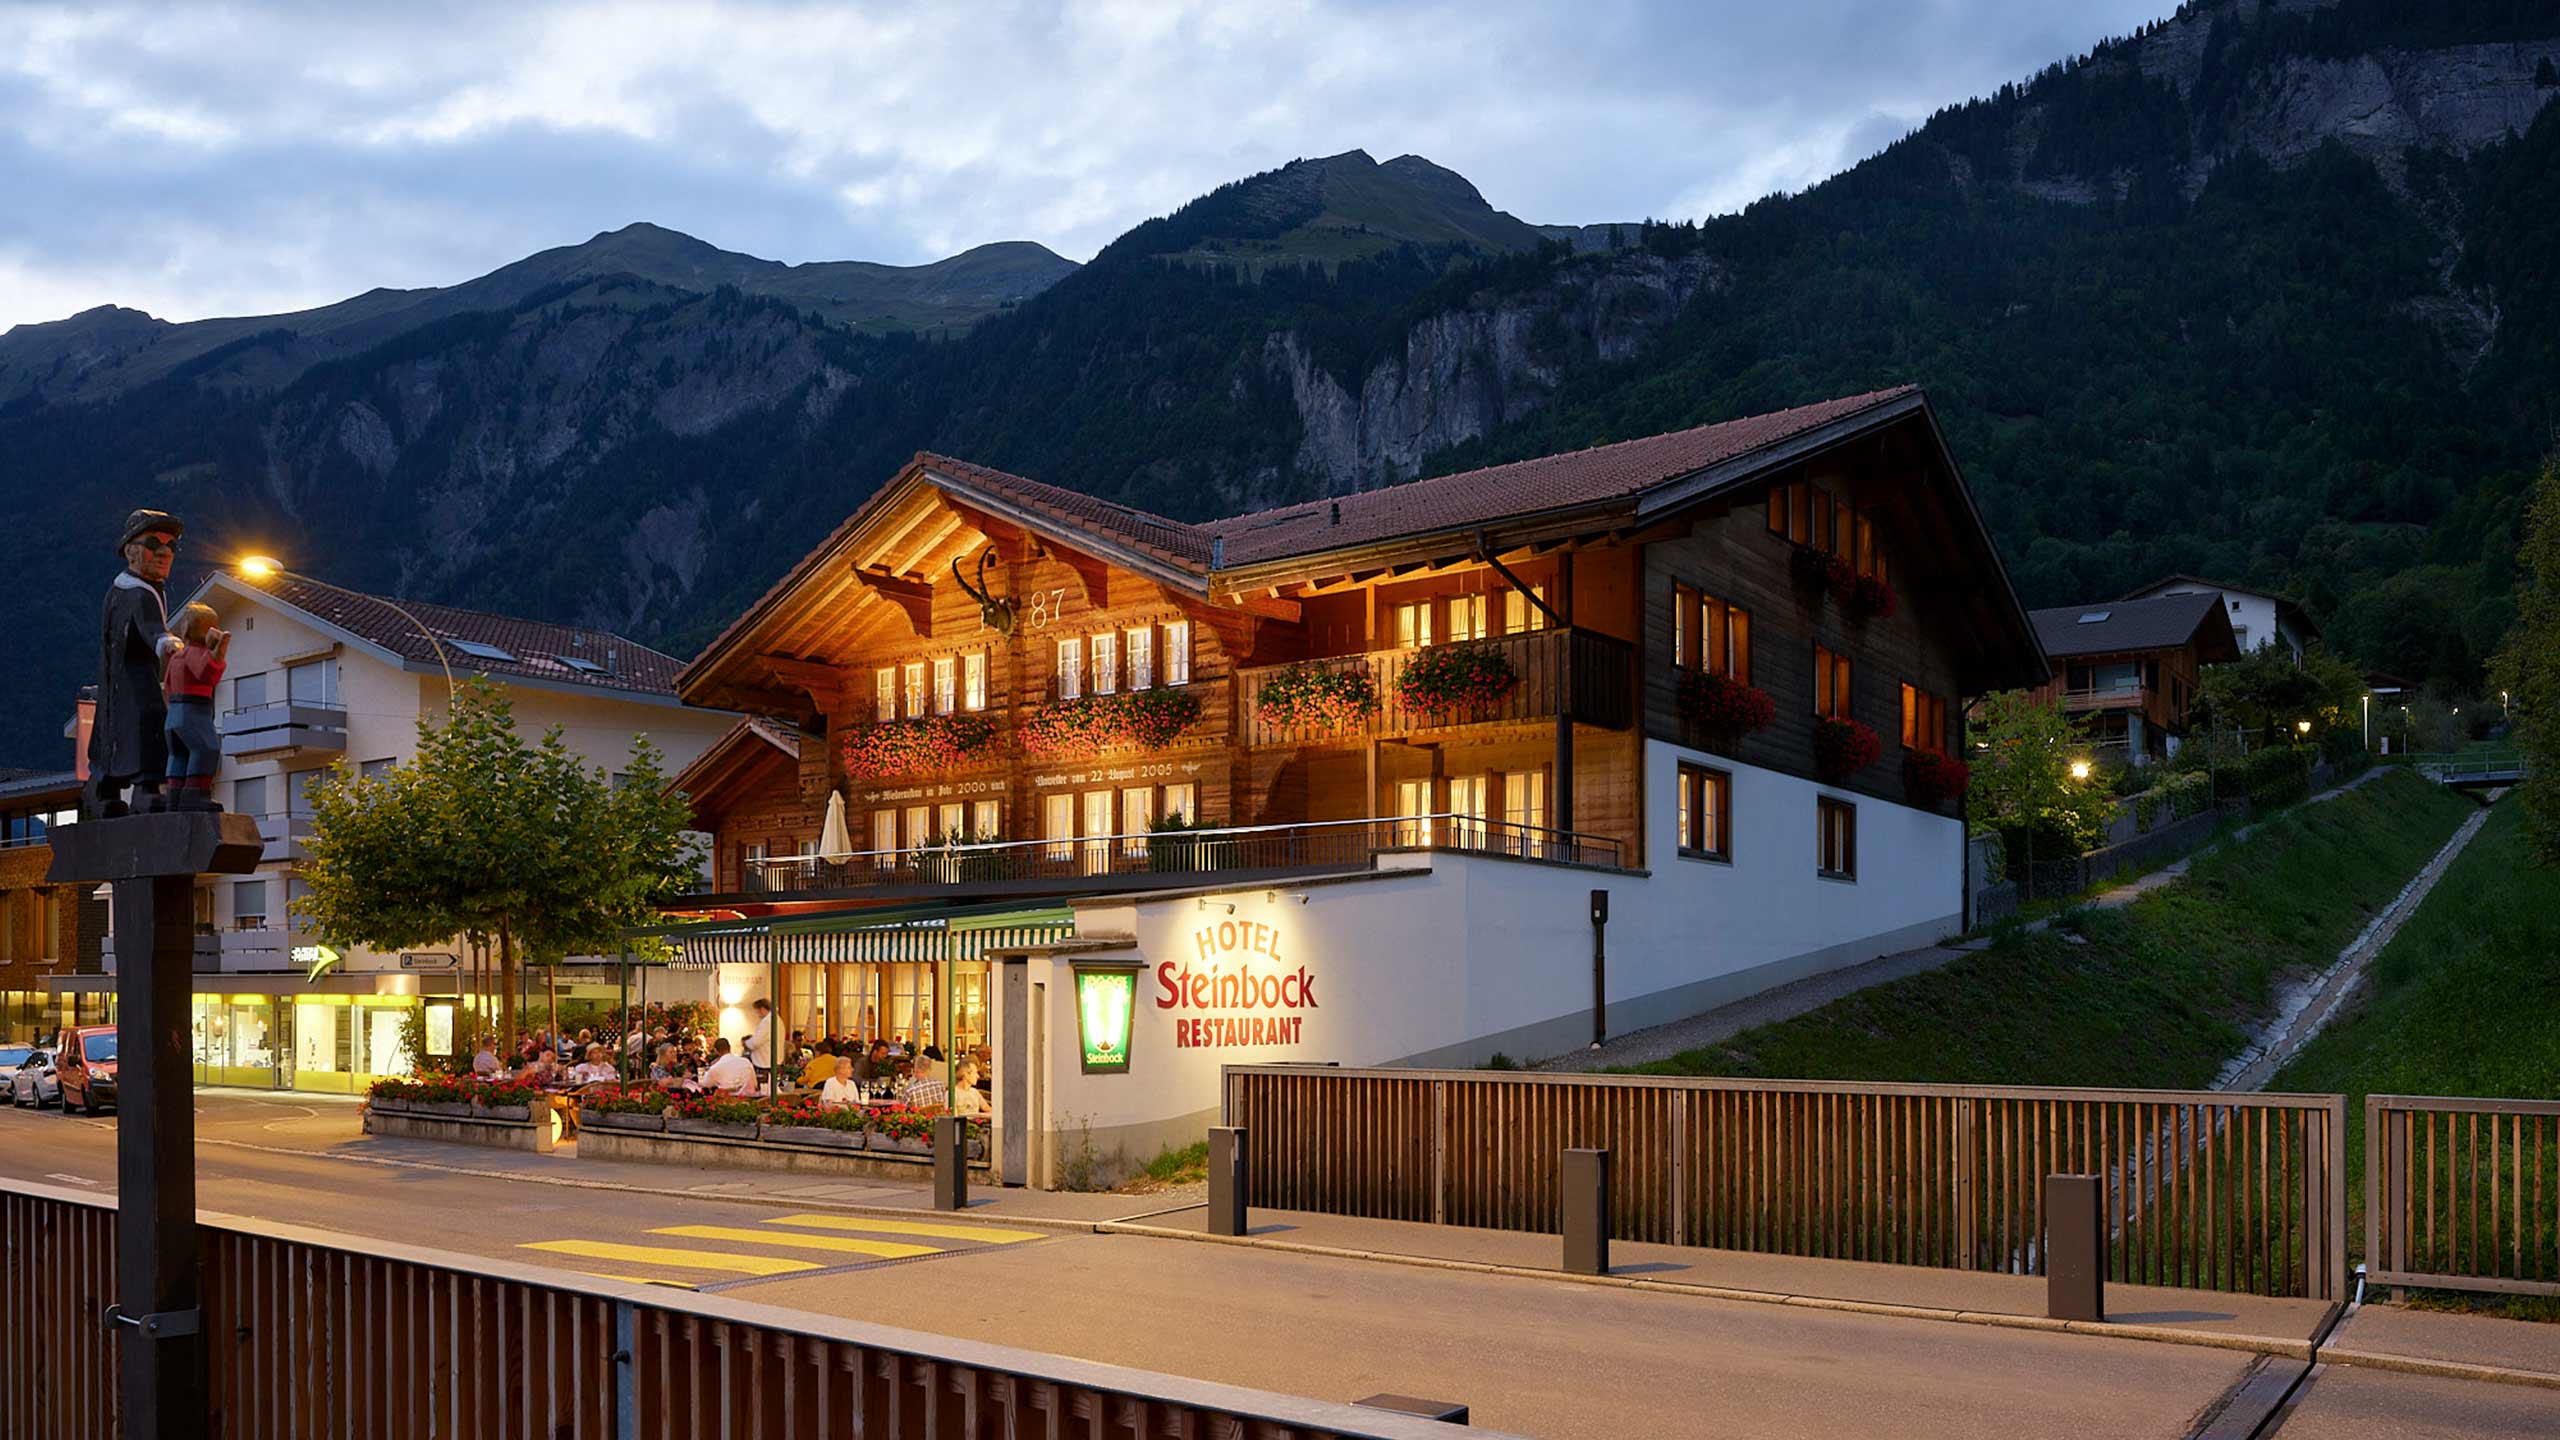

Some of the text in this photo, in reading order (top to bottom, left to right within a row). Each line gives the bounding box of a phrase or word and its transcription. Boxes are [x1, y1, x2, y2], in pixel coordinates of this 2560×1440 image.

[957, 781, 986, 794] 2006
[1090, 769, 1104, 782] 22
[1141, 763, 1173, 777] 2005
[1195, 920, 1281, 962] HOTEL
[1156, 960, 1319, 1009] Steinbock
[1176, 1016, 1302, 1048] RESTAURANT
[1087, 1052, 1124, 1064] Steinbock
